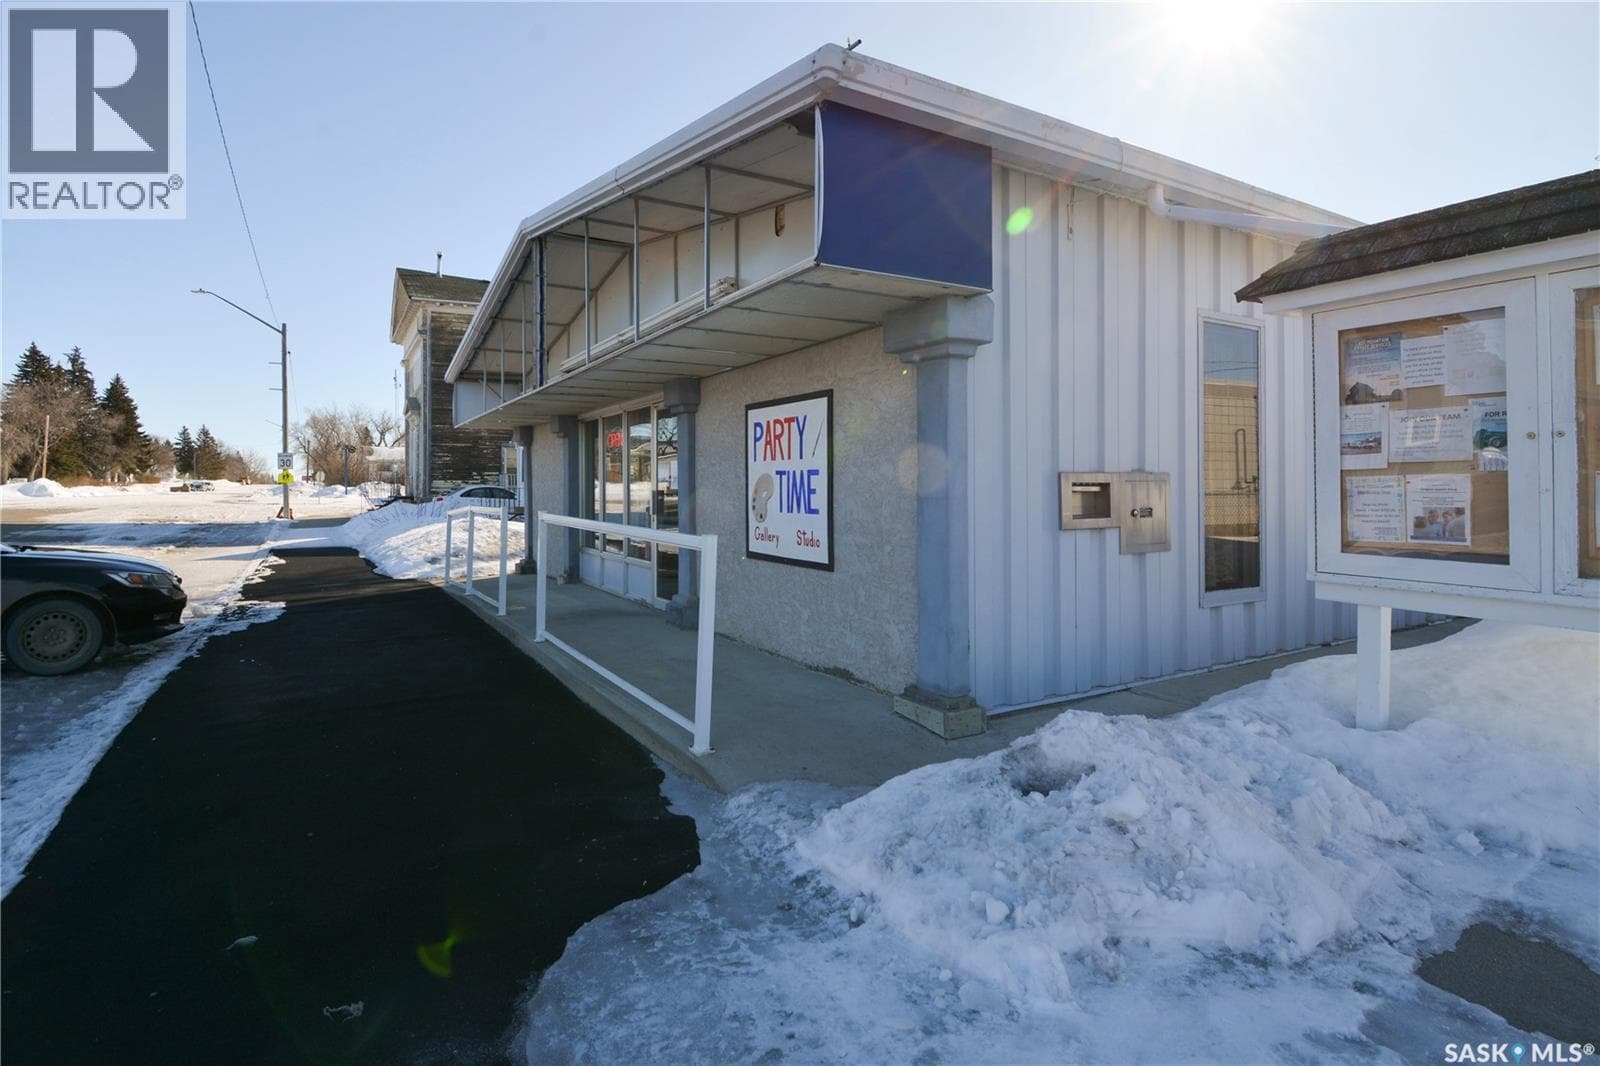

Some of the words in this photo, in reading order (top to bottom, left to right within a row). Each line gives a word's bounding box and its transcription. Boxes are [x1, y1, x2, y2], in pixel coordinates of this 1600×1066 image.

[753, 415, 807, 462] PARTY
[280, 459, 291, 467] 30
[775, 469, 820, 515] TIME
[754, 526, 780, 548] Gallery
[796, 529, 821, 548] Studio
